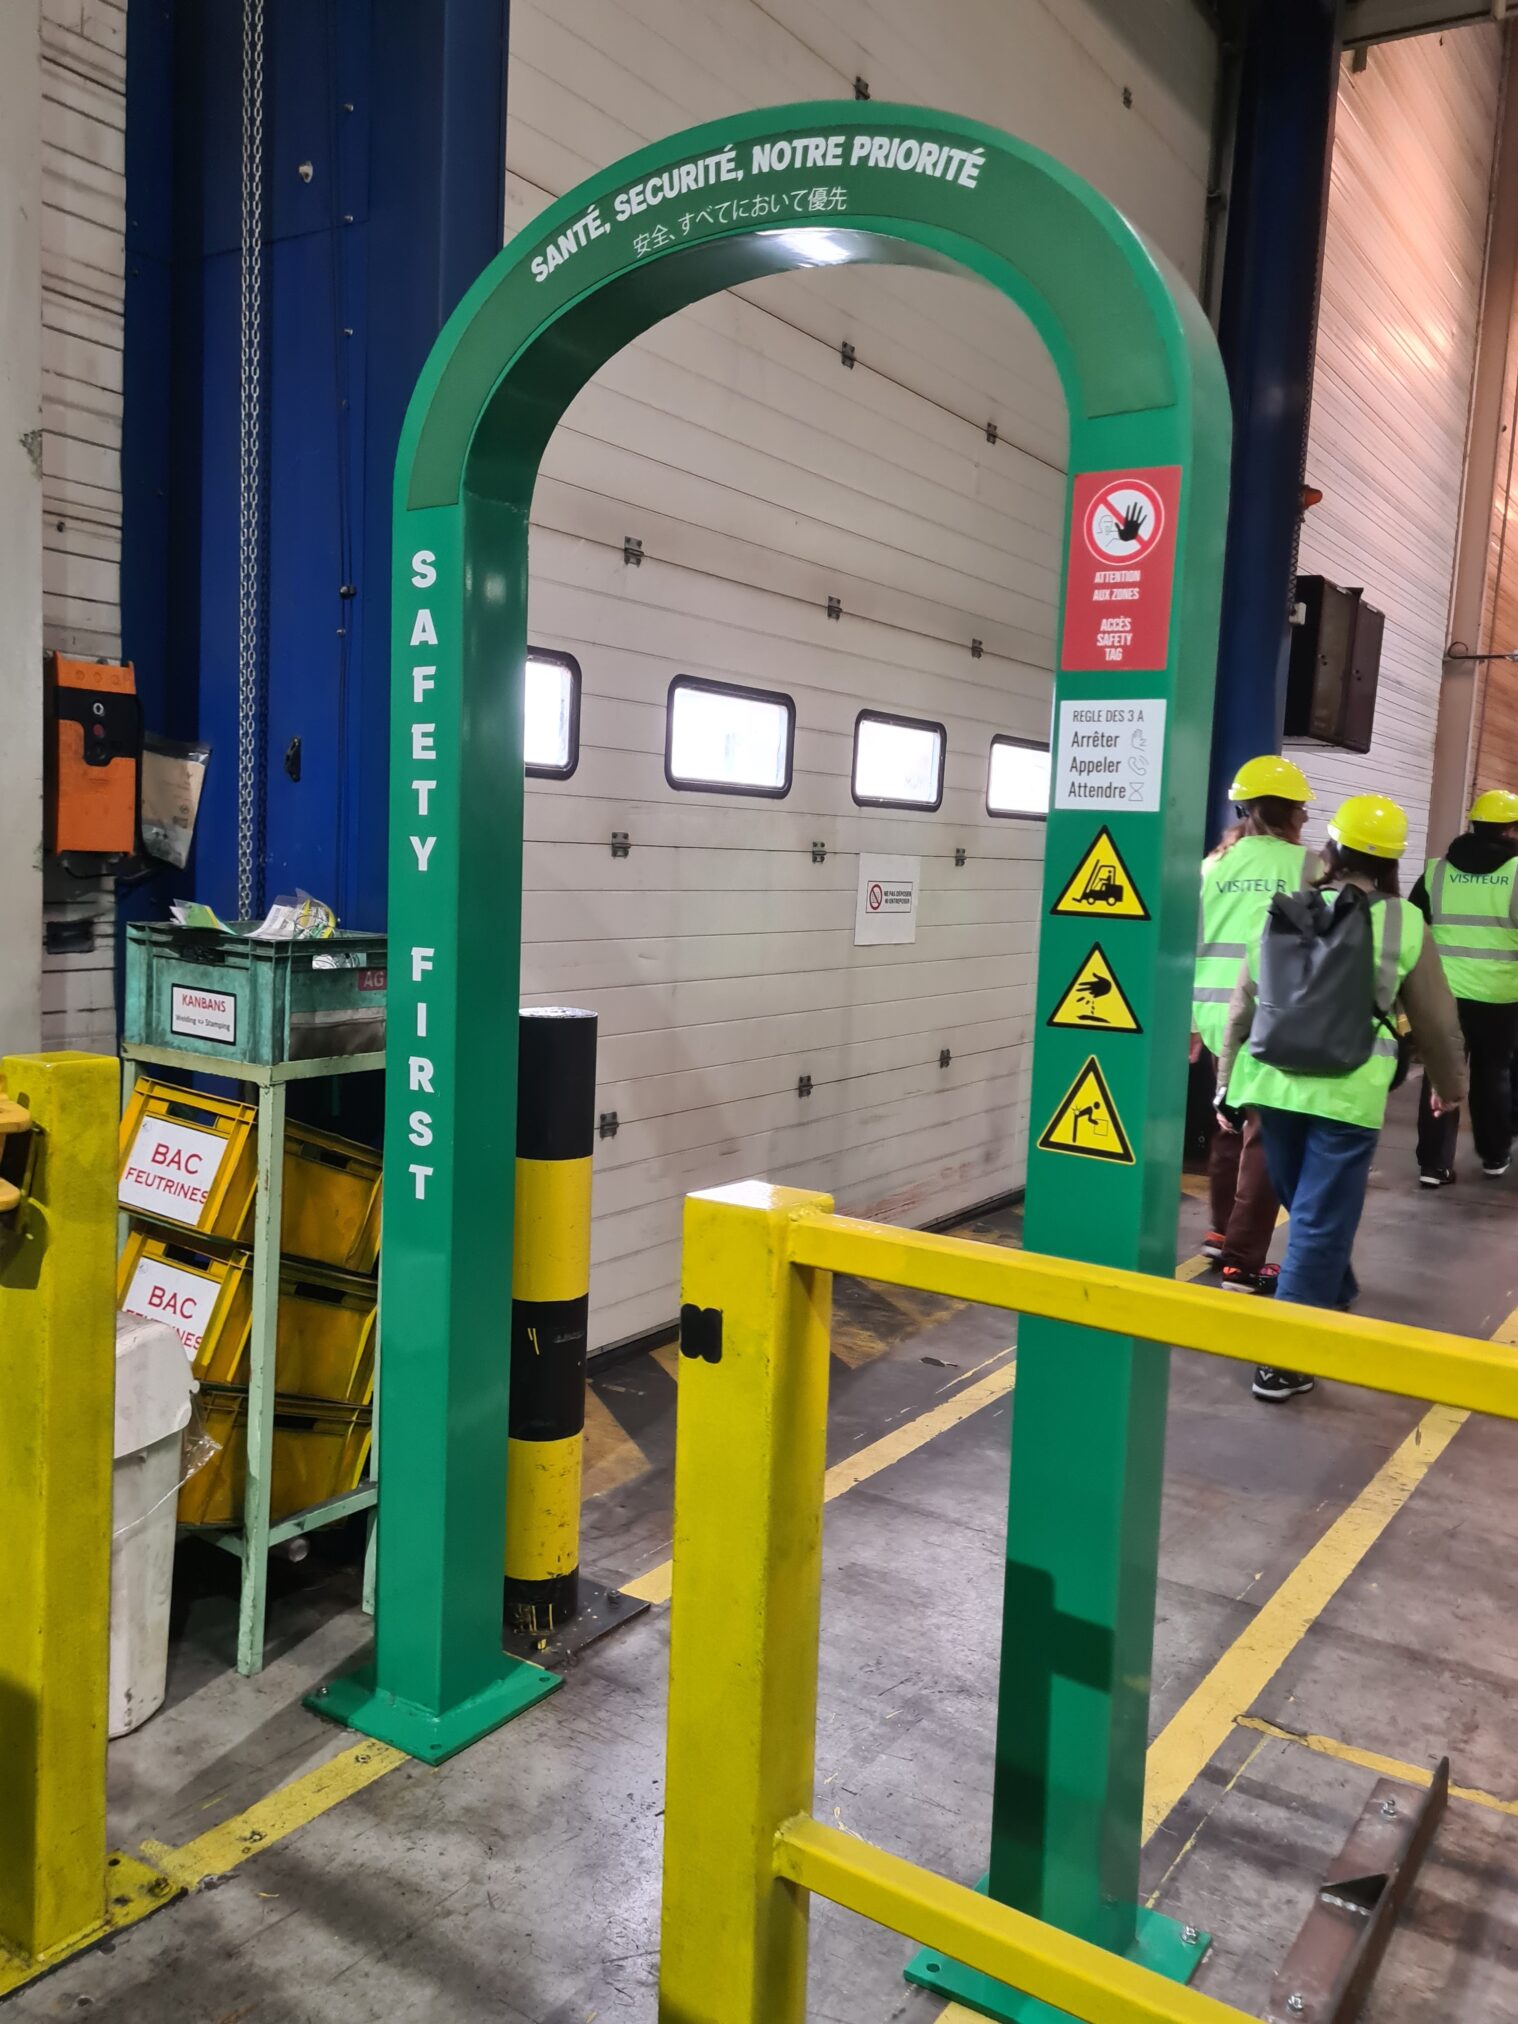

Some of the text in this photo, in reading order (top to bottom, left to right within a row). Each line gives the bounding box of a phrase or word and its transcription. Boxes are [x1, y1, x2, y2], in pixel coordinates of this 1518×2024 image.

[531, 135, 986, 283] SANTÉ, SECURITÉ, NOTRE PRIORITÉ
[633, 186, 848, 258] 安全、すべてにおいて優先
[1094, 570, 1141, 583] ATTENTION
[1093, 589, 1110, 600] AUX
[1096, 633, 1133, 646] SAFETY
[1104, 647, 1123, 661] TAG
[1072, 710, 1144, 722] REGLE DES 3 A
[1071, 731, 1120, 748] Arrêter
[1069, 756, 1121, 776] Appeler
[1068, 781, 1126, 799] Attendre
[408, 549, 438, 1201] SAFETY FIRST
[1450, 874, 1509, 886] VISITEUR
[1216, 879, 1287, 893] VISITEUR
[182, 993, 226, 1013] KANBANS
[151, 1143, 203, 1175] BAC
[125, 1167, 208, 1205] FEUTRINES
[147, 1285, 197, 1319] BAC
